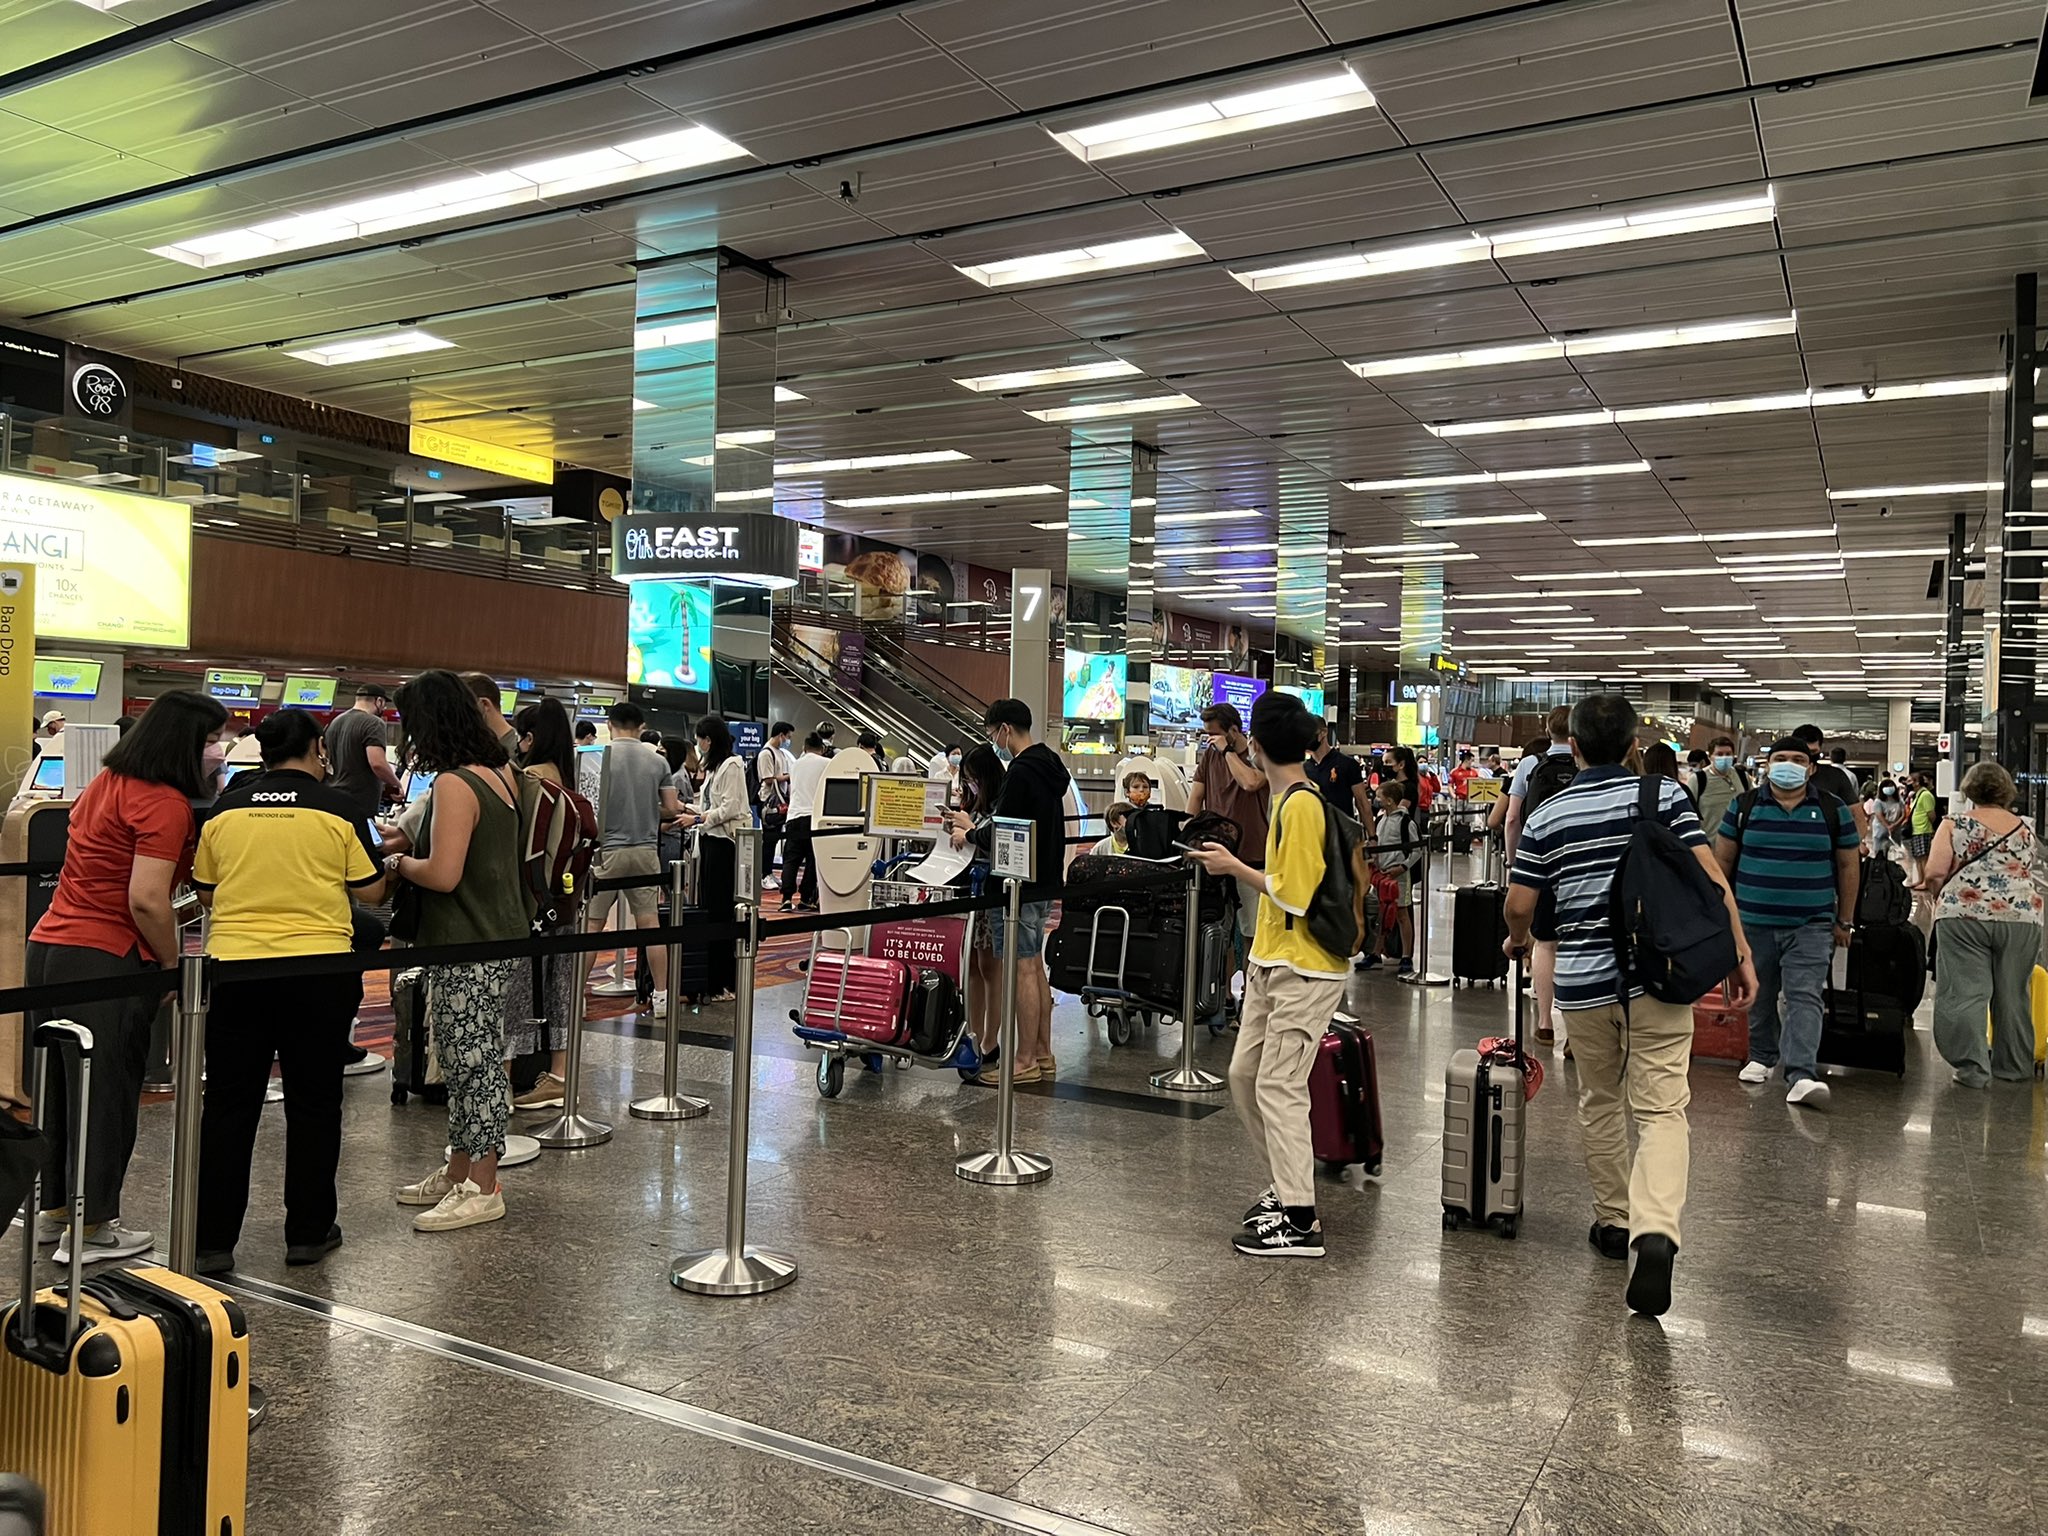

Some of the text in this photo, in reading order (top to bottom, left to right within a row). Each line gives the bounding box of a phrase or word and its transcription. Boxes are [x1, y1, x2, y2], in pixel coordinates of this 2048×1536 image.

[84, 375, 117, 396] Root
[89, 394, 112, 415] 98
[417, 433, 450, 455] TGM
[28, 495, 95, 513] GETAWAY?
[655, 526, 740, 548] FAST
[655, 546, 740, 560] Check-In
[1019, 586, 1042, 622] 7
[0, 639, 14, 676] Drop
[251, 791, 298, 802] scoot
[882, 948, 946, 963] TO BE LOVED.
[886, 938, 944, 952] IT'S A TREAT
